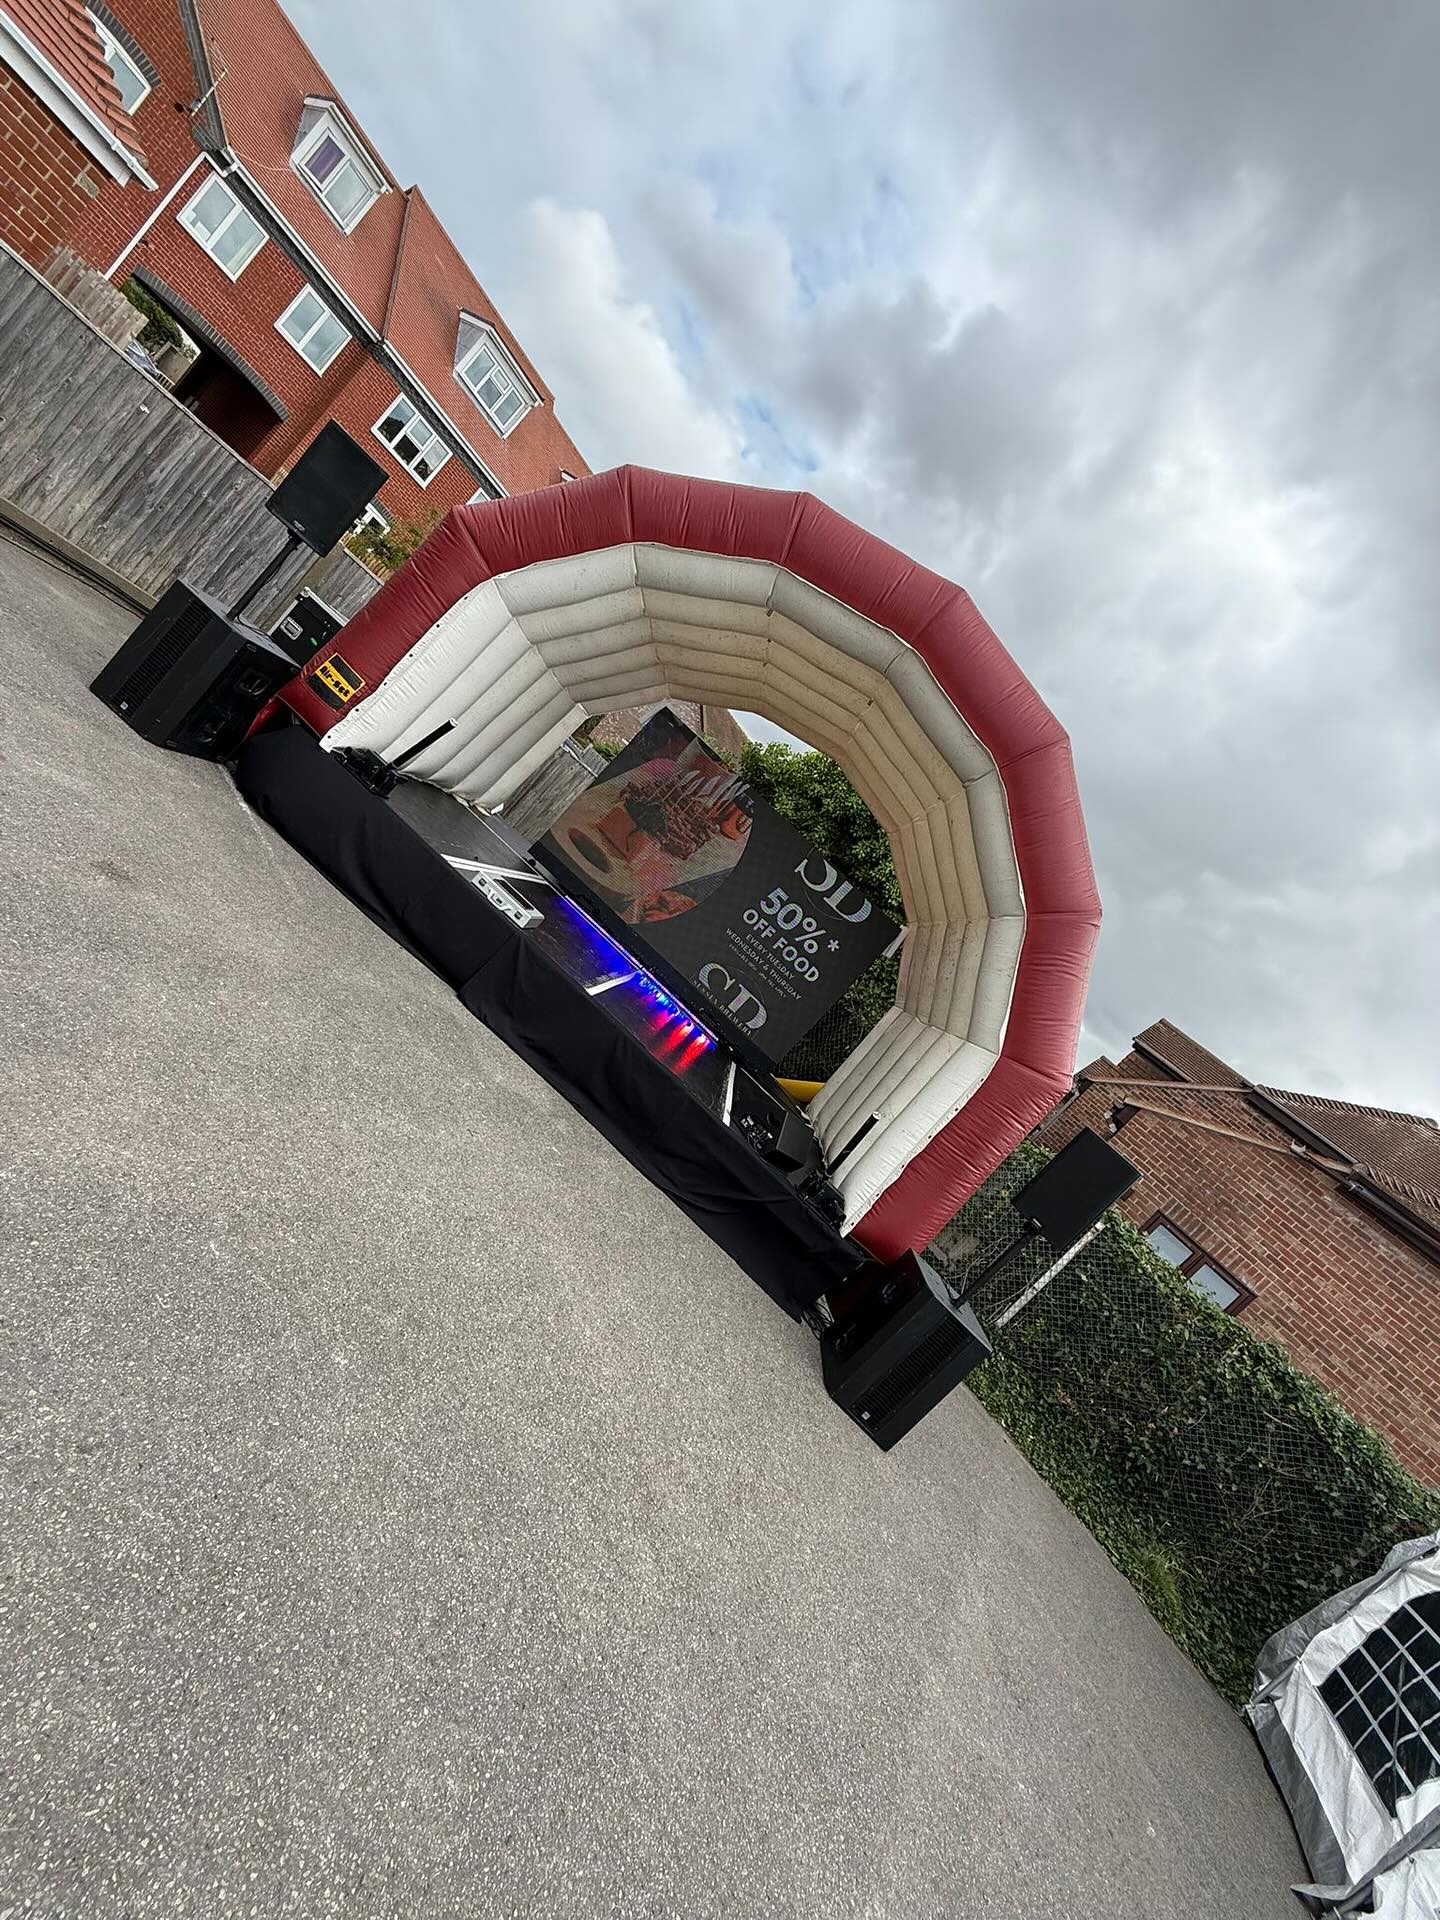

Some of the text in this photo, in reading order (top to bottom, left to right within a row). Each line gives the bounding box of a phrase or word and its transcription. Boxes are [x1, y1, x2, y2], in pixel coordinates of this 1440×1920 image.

[319, 665, 350, 697] Air-Set
[726, 928, 765, 965] WEDNESDAY
[769, 969, 802, 1000] THURSDAY
[742, 908, 820, 982] OFF FOOD
[745, 933, 795, 980] EVERY TUESDAY
